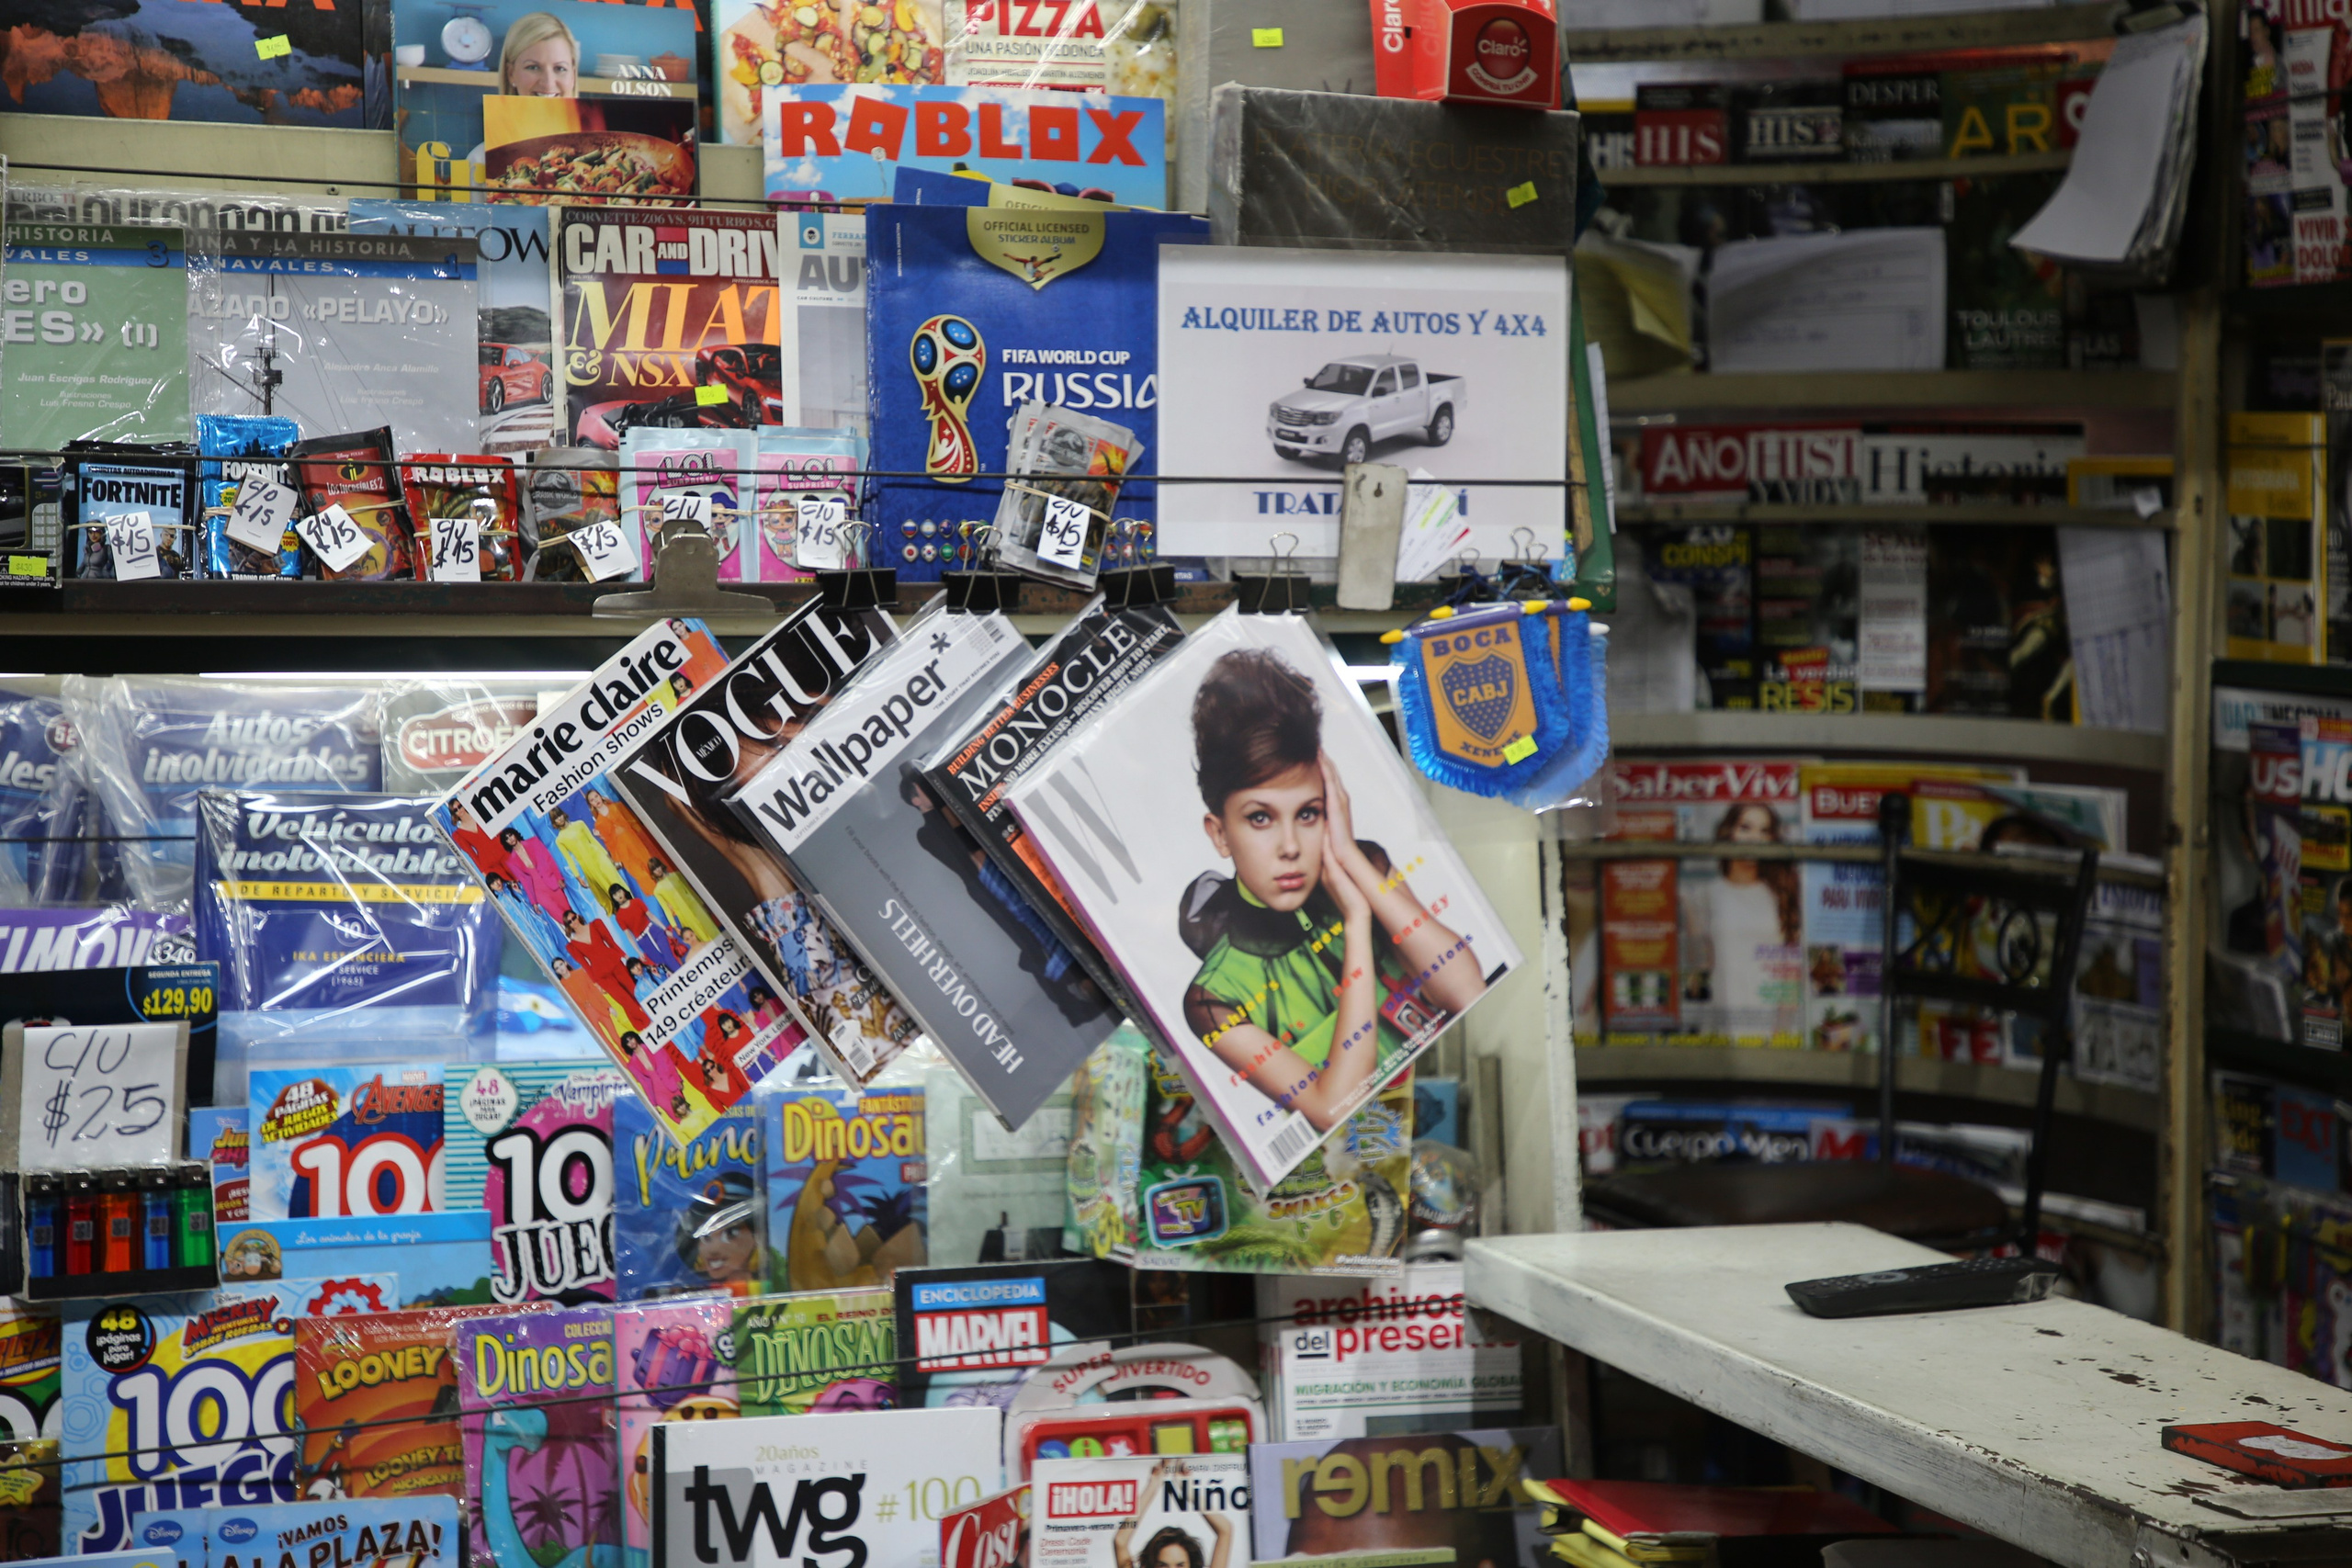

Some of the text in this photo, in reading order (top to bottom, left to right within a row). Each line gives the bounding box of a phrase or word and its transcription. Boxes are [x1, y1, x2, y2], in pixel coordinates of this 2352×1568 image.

[966, 0, 1105, 39] PIZZA
[966, 39, 1042, 56] UNA PASIÓN
[1477, 37, 1524, 57] Claro
[616, 63, 666, 81] ANNA
[611, 80, 672, 96] OLSON
[780, 95, 1146, 166] ROBLOX
[1641, 124, 1723, 165] HIS
[1409, 139, 1564, 178] ECUESTRE
[7, 226, 115, 243] HISTORIA
[565, 210, 640, 224] CORVETTE
[668, 214, 686, 226] VS.
[707, 216, 747, 228] TURBO
[983, 220, 1091, 235] OFFICIAL LICENSED
[145, 240, 170, 268] 3
[249, 237, 260, 251] Y
[274, 239, 298, 252] LA
[311, 239, 411, 256] HISTORIA
[565, 223, 657, 275] CAR
[658, 243, 688, 260] AND
[998, 233, 1076, 246] STICKER ALBUM
[213, 256, 335, 273] NAVALES
[303, 296, 449, 324] «PELAYO»
[565, 281, 780, 352] MIAT
[1182, 307, 1547, 336] ALQUILER DE AUTOS Y 4X4
[565, 350, 696, 387] & NSX
[1002, 349, 1131, 366] FIFA WORLD CUP
[17, 372, 154, 387] Juan Escrigas Rodríguez
[1002, 372, 1158, 410] RUSSIA
[40, 399, 131, 411] Luis Fresno Crespo
[1655, 429, 1747, 486] AÑO
[326, 477, 385, 496] LOS INCREÍBLES 2
[415, 465, 507, 485] ROBLOX
[666, 476, 714, 487] SURPRISE!
[787, 480, 834, 491] SURPRISE!
[81, 478, 183, 509] FORTNITE
[1431, 626, 1513, 659] BOCA
[1037, 717, 1070, 752] EXCUSES
[1075, 678, 1114, 717] DISCOVER
[1141, 623, 1172, 655] START,
[1453, 680, 1509, 707] CABJ
[624, 602, 883, 807] VOGUE
[946, 660, 1060, 776] BUILDING BUSINESSES
[957, 618, 1137, 802] MONOCLE
[201, 709, 312, 745] Autos
[469, 639, 684, 825] marie claire
[532, 703, 663, 813] Fashion shows
[695, 736, 722, 761] MÉXICO
[142, 746, 369, 785] inolvidables
[247, 811, 442, 843] Vehículos
[1022, 754, 1143, 906] W
[241, 885, 261, 897] DE
[877, 897, 937, 967] HEELS
[293, 950, 317, 963] IKA
[1202, 855, 1425, 1049] fashion's new faces
[148, 968, 212, 980] SEGUNDA ENTREGA
[342, 964, 379, 976] SERVICE
[646, 937, 735, 1016] Printemps
[142, 986, 213, 1020] $129,90
[646, 953, 752, 1046] 149 créateurs
[1230, 1020, 1306, 1089] fashion's
[1331, 966, 1365, 998] new
[1391, 894, 1452, 945] energy
[971, 1012, 1025, 1076] HEAD
[1256, 1057, 1331, 1128] fashion's
[1341, 1019, 1374, 1052] new
[1385, 932, 1475, 1011] obsessions
[44, 1029, 132, 1079] C/U
[401, 1070, 427, 1082] MARVEL
[476, 1077, 500, 1096] 48
[274, 1090, 330, 1119] PÁGINAS
[284, 1081, 315, 1103] 48
[42, 1078, 167, 1149] $25
[261, 1111, 340, 1145] ACTIVIDADES
[281, 1102, 329, 1127] JUEGOS
[1266, 1179, 1360, 1221] SNAKES
[213, 1292, 243, 1304] Disney
[920, 1284, 1042, 1305] ENCICLOPEDIA
[1294, 1287, 1466, 1326] archivos
[100, 1308, 138, 1333] 48
[183, 1295, 280, 1347] MICKEY
[211, 1315, 261, 1335] AVENTURAS
[817, 1308, 876, 1324] EL REINO
[96, 1333, 142, 1348] ¡páginas
[107, 1345, 130, 1356] para
[184, 1322, 274, 1359] SOBRE RUEDAS
[917, 1311, 1049, 1369] MARVEL
[1295, 1331, 1330, 1351] del
[103, 1349, 135, 1365] jugar!
[1052, 1350, 1114, 1394] SUPER
[317, 1346, 447, 1402] LOONEY
[1295, 1375, 1466, 1396] MIGRACIÓN ECONOMÍA
[364, 1448, 439, 1489] LOONEY
[754, 1444, 820, 1463] 20años
[754, 1459, 869, 1475] MAGAZINE
[1162, 1478, 1250, 1514] Niño
[1282, 1444, 1533, 1519] remix
[874, 1474, 982, 1524] #100
[1051, 1481, 1136, 1517] ¡HOLA!
[222, 1523, 256, 1538] Disney
[684, 1464, 869, 1568] twg
[146, 1526, 182, 1541] Disney
[277, 1514, 349, 1550] ¡VAMOS
[308, 1519, 443, 1568] PLAZA!
